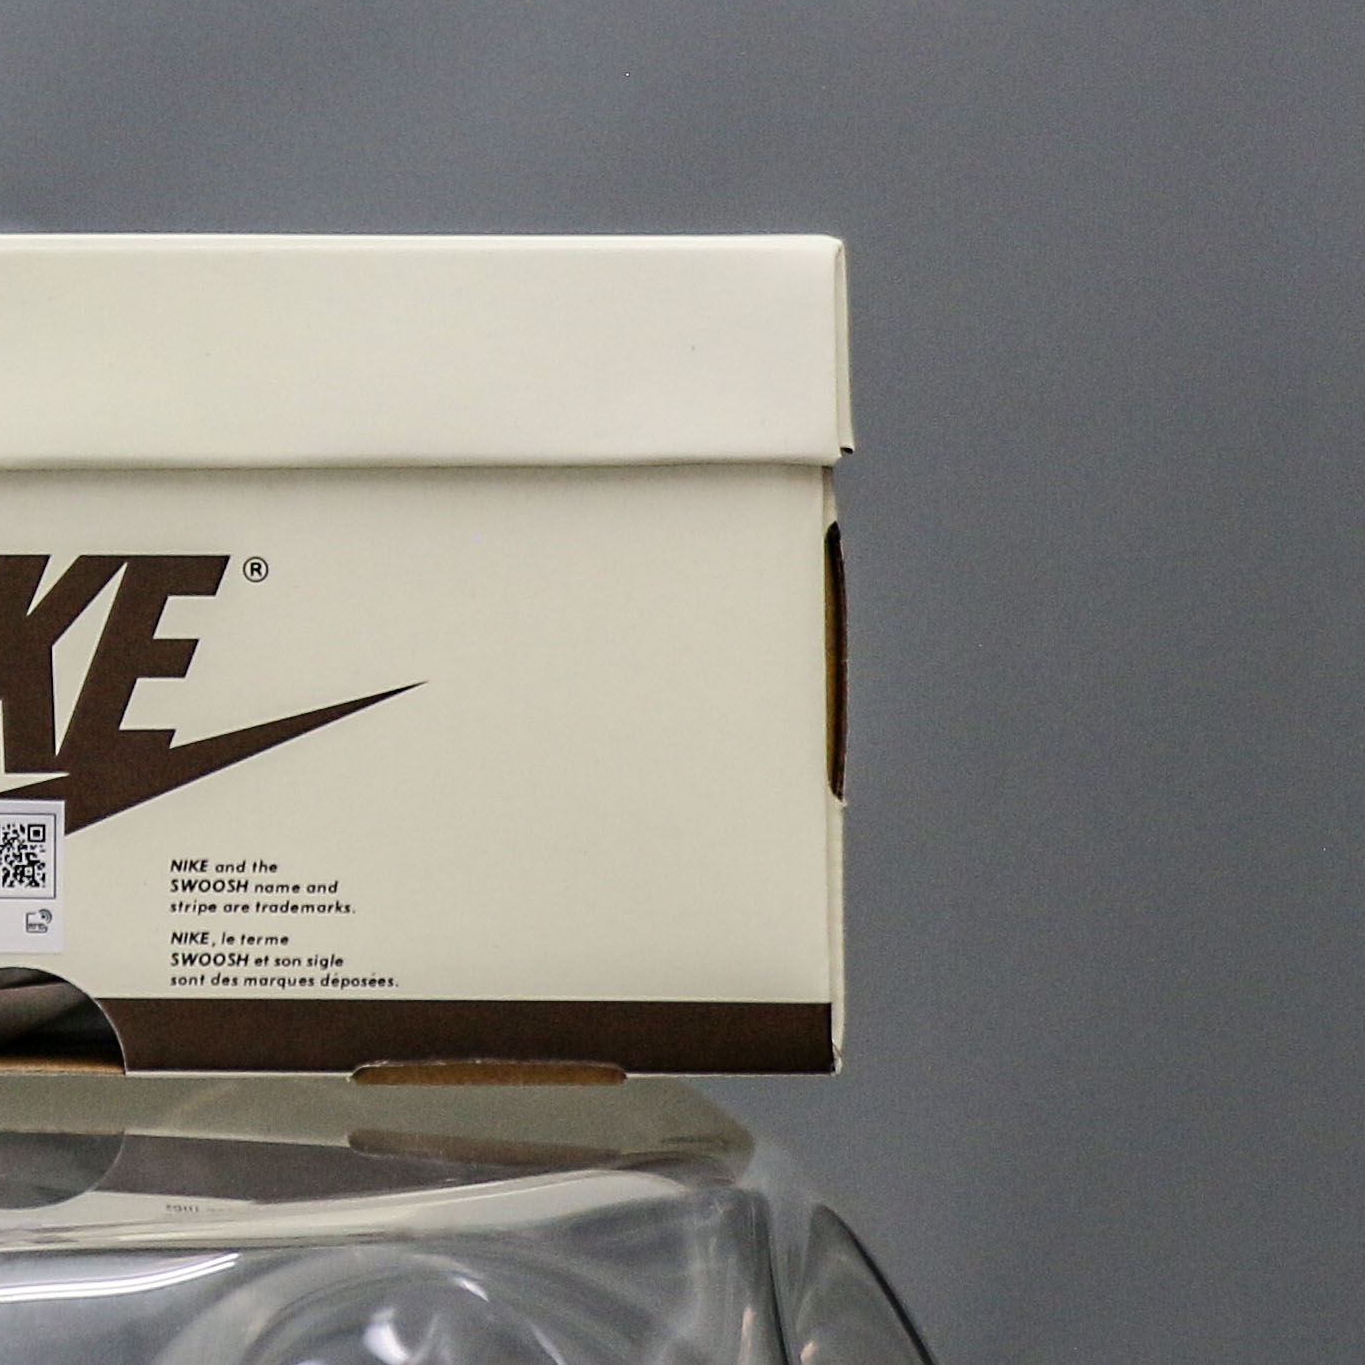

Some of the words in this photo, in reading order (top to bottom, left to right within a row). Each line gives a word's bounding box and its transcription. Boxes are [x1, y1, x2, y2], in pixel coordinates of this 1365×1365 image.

[170, 859, 209, 873] NIKE
[214, 860, 246, 874] and
[252, 859, 278, 874] the
[169, 878, 249, 894] SWOOSH
[254, 882, 301, 894] name
[306, 880, 339, 895] and
[170, 899, 218, 916] stripe
[223, 903, 250, 914] are
[255, 899, 357, 914] trademarks.
[170, 931, 216, 948] NIKE,
[221, 932, 236, 946] le
[240, 933, 290, 946] terme
[169, 952, 249, 968] SWOOSH
[254, 955, 270, 968] et
[274, 957, 302, 968] son
[306, 954, 345, 971] sigle
[170, 974, 206, 987] sont
[210, 972, 239, 987] des
[243, 976, 315, 991] marques
[320, 972, 400, 991] déposées.
